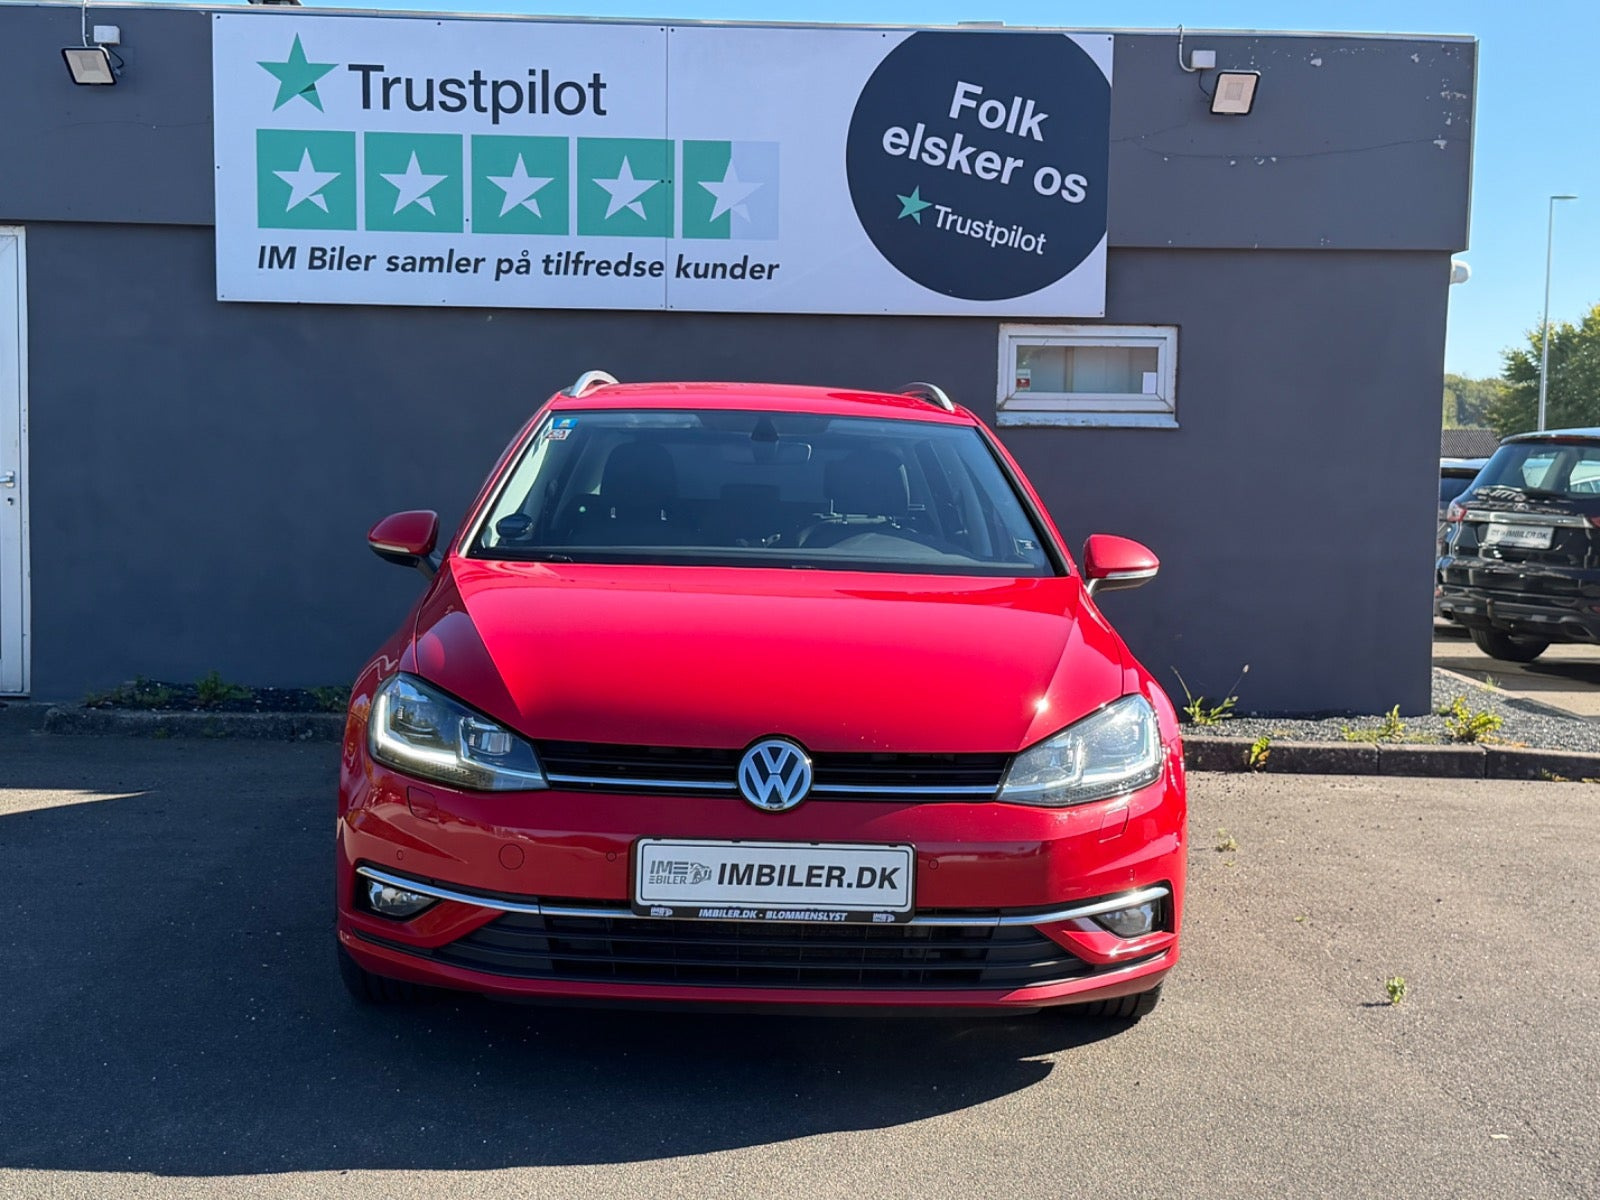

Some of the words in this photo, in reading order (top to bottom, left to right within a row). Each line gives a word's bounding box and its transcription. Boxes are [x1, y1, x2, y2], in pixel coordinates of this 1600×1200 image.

[348, 63, 608, 125] Trustpilot
[949, 80, 1049, 142] Folk
[882, 122, 1024, 185] elsker
[1033, 166, 1088, 203] os
[935, 204, 1047, 255] Trustpilot
[257, 245, 297, 270] IM
[308, 246, 377, 272] Biler
[385, 251, 486, 275] samler
[495, 249, 532, 281] på
[541, 251, 665, 278] tilfredse
[675, 254, 780, 281] kunder
[717, 862, 902, 890] IMBILER.DK
[698, 908, 757, 919] IMBILER.DK
[764, 910, 848, 922] BLOMMENSLYST
